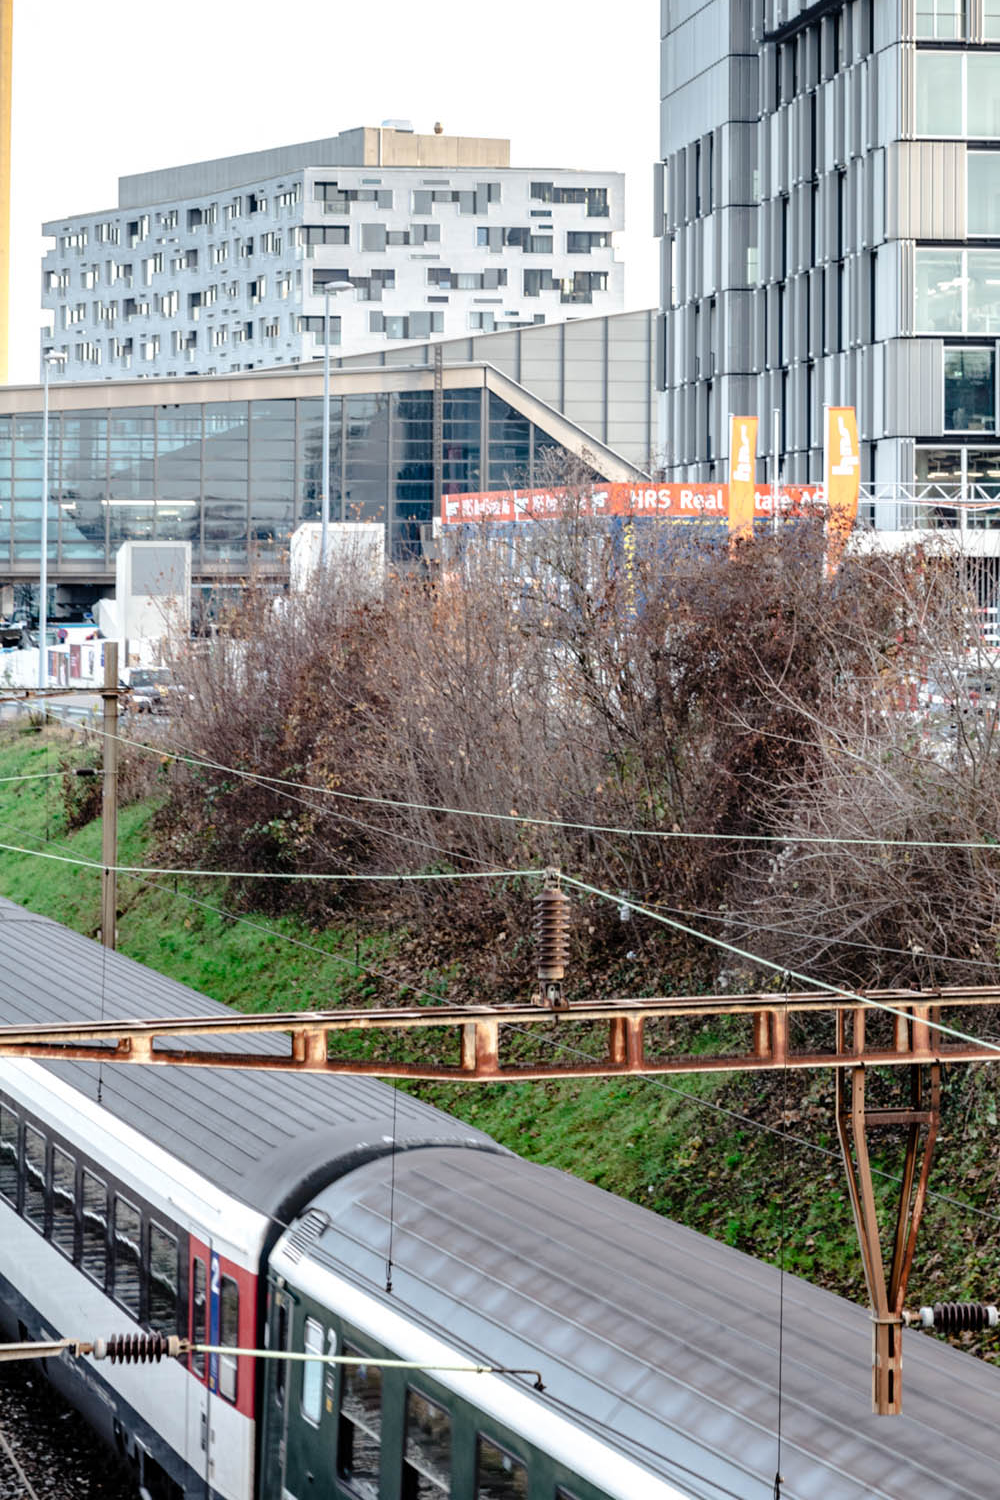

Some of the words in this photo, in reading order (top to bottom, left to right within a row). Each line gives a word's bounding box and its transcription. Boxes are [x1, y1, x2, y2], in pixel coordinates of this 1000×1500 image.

[631, 489, 671, 509] HRS
[680, 489, 723, 509] Real
[211, 1257, 219, 1295] 2
[327, 1327, 337, 1368] 2
